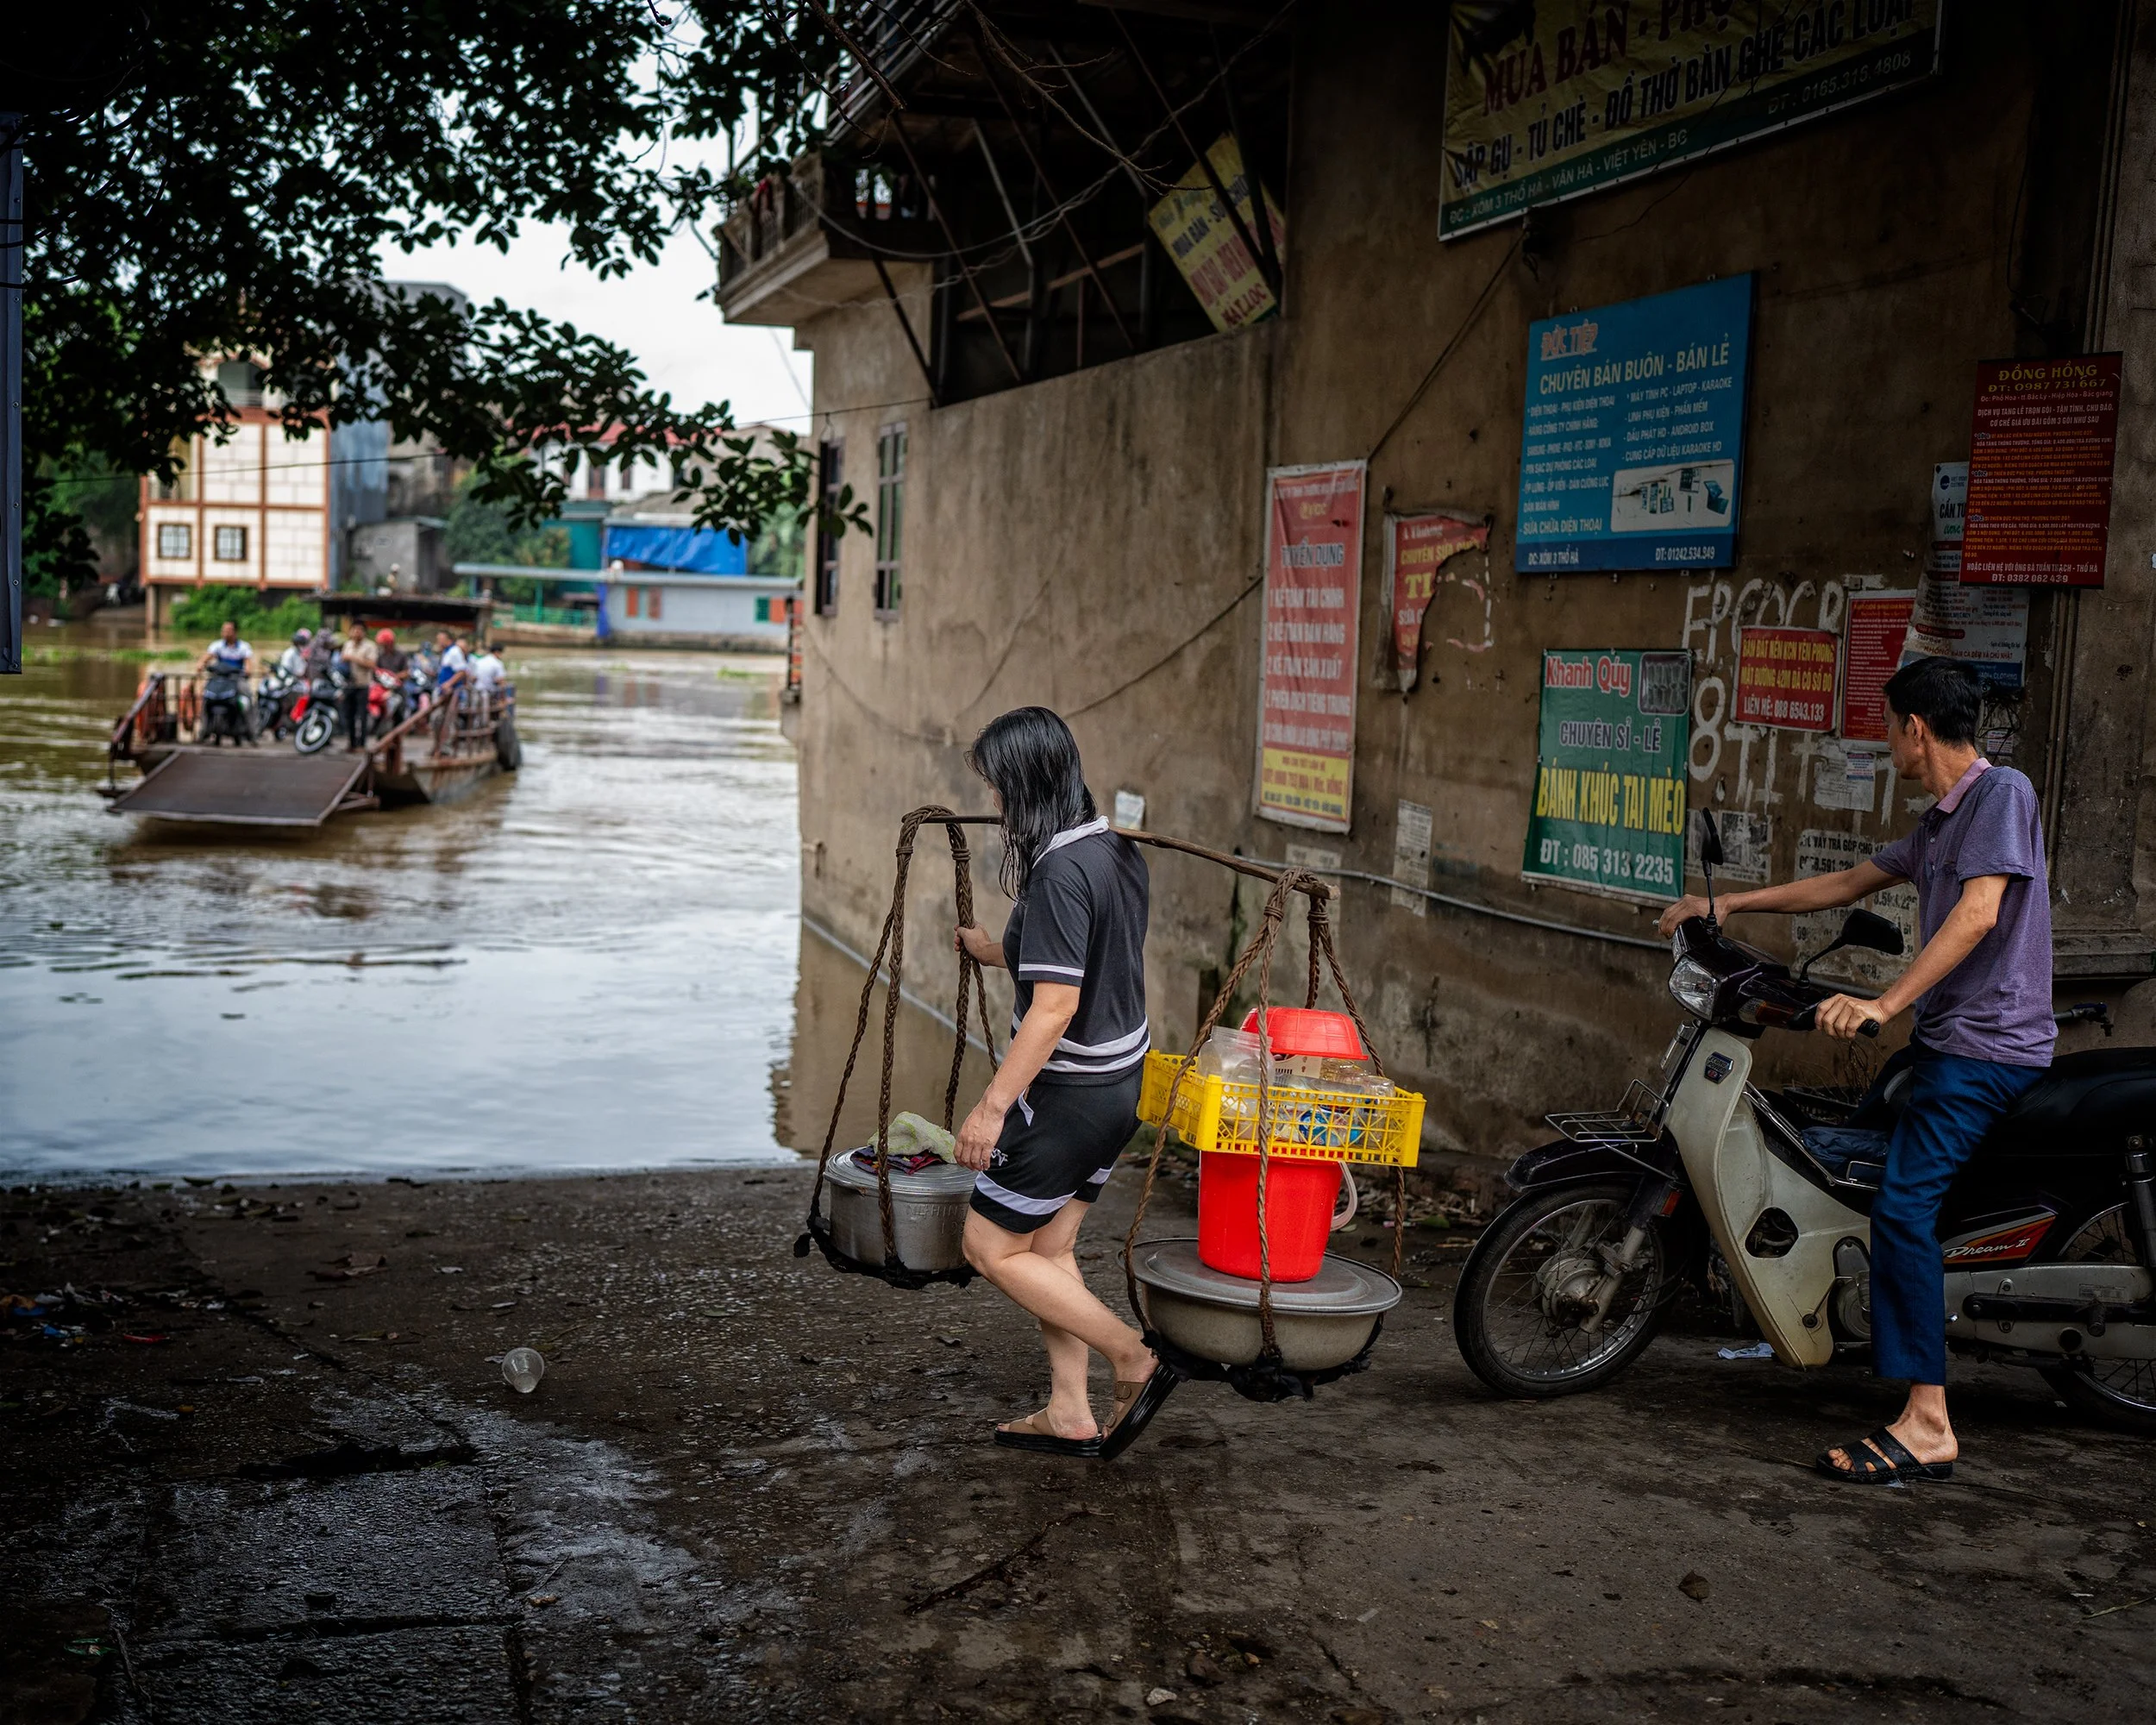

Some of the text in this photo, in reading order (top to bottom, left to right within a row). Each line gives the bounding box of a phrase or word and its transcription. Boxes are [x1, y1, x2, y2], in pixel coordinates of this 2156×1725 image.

[1482, 0, 1629, 117] MUA BÁN
[1528, 102, 1548, 160] TỦ
[1553, 95, 1587, 152] CHÈ
[1605, 68, 1636, 130] ĐỒ
[1640, 55, 1682, 119] THỜ
[1685, 44, 1732, 104] BÀN
[1793, 0, 1846, 62] CÁC
[1576, 158, 1594, 181] HÀ
[1603, 147, 1630, 172] VIỆT
[1631, 135, 1658, 160] YÊN
[1539, 332, 1730, 396] CHUYÊN BÁN BUÔN BÁN LẺ
[1660, 386, 1670, 399] PC
[1672, 381, 1698, 397] LAPTOP
[1702, 376, 1733, 392] KARAOKE
[2015, 382, 2051, 392] 0987
[2055, 380, 2076, 390] 731
[2078, 378, 2107, 388] 667
[1700, 420, 1714, 434] BOX
[2087, 415, 2100, 424] SAU
[1625, 448, 1643, 462] CUNG
[1681, 442, 1712, 455] KARAOKE
[1712, 441, 1722, 453] HD
[1579, 518, 1603, 536] THOẠI
[2007, 574, 2028, 583] 0382
[2031, 574, 2048, 583] 062
[1545, 656, 1594, 689] Khanh
[1559, 715, 1663, 754] CHUYÊN SỈ LẺ
[1536, 756, 1687, 837] BÁNH KHÚC TAI MÈO
[1572, 842, 1600, 873] 085
[1602, 847, 1632, 879] 313
[1633, 852, 1675, 887] 2235
[1944, 1244, 2015, 1258] Dream
